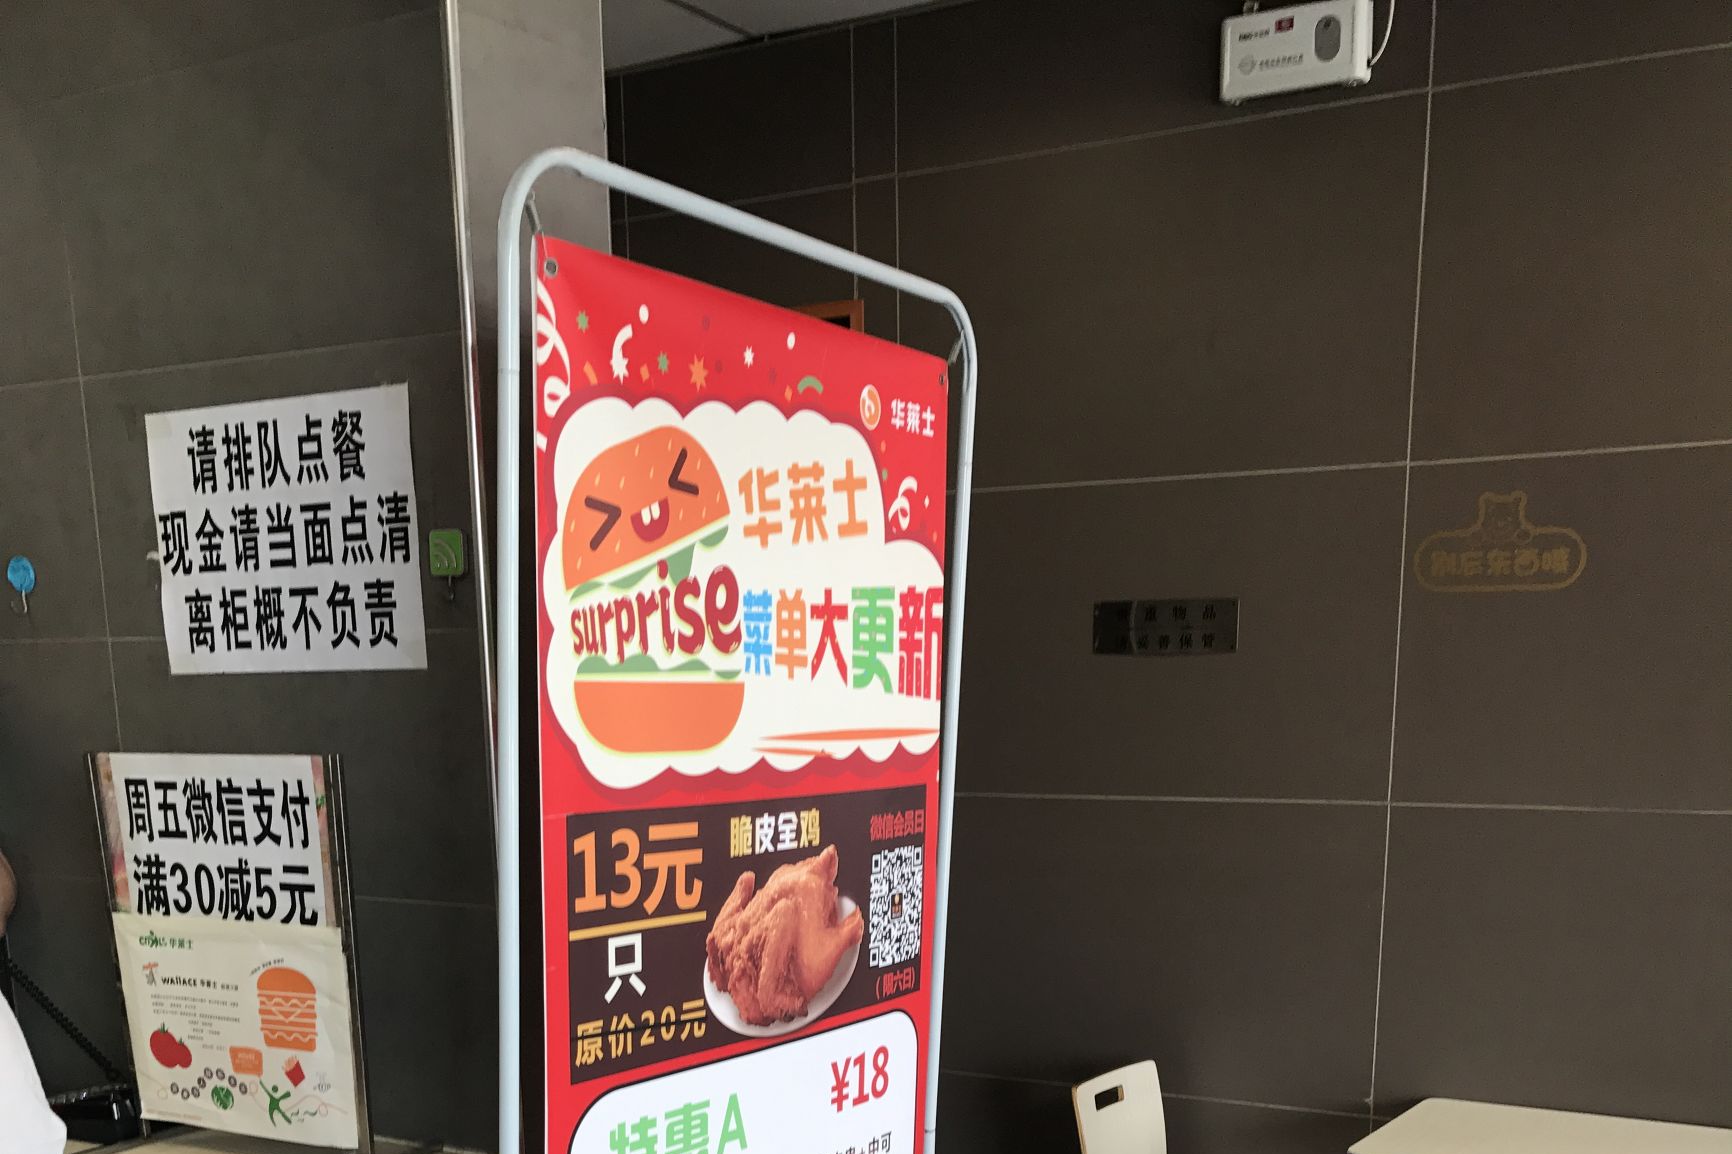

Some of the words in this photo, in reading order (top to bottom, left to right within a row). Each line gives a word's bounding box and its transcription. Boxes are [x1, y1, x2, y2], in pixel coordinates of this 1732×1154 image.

[187, 409, 366, 494] 请排队点餐
[890, 398, 936, 438] 华莱士
[158, 490, 412, 577] 现金请当面点清
[738, 458, 869, 549] 华莱士
[184, 578, 399, 654] 离柜概不负责
[570, 560, 743, 664] surprise
[742, 585, 944, 701] 菜单大更新
[124, 777, 310, 849] 周五微信支付
[729, 808, 821, 859] 脆皮全鸡
[869, 808, 925, 842] 微信会员日
[133, 854, 319, 926] 满30减5元
[573, 821, 704, 916] 13元
[604, 932, 647, 1004] 只
[575, 998, 707, 1068] 原价20元
[830, 1045, 890, 1114] ¥18
